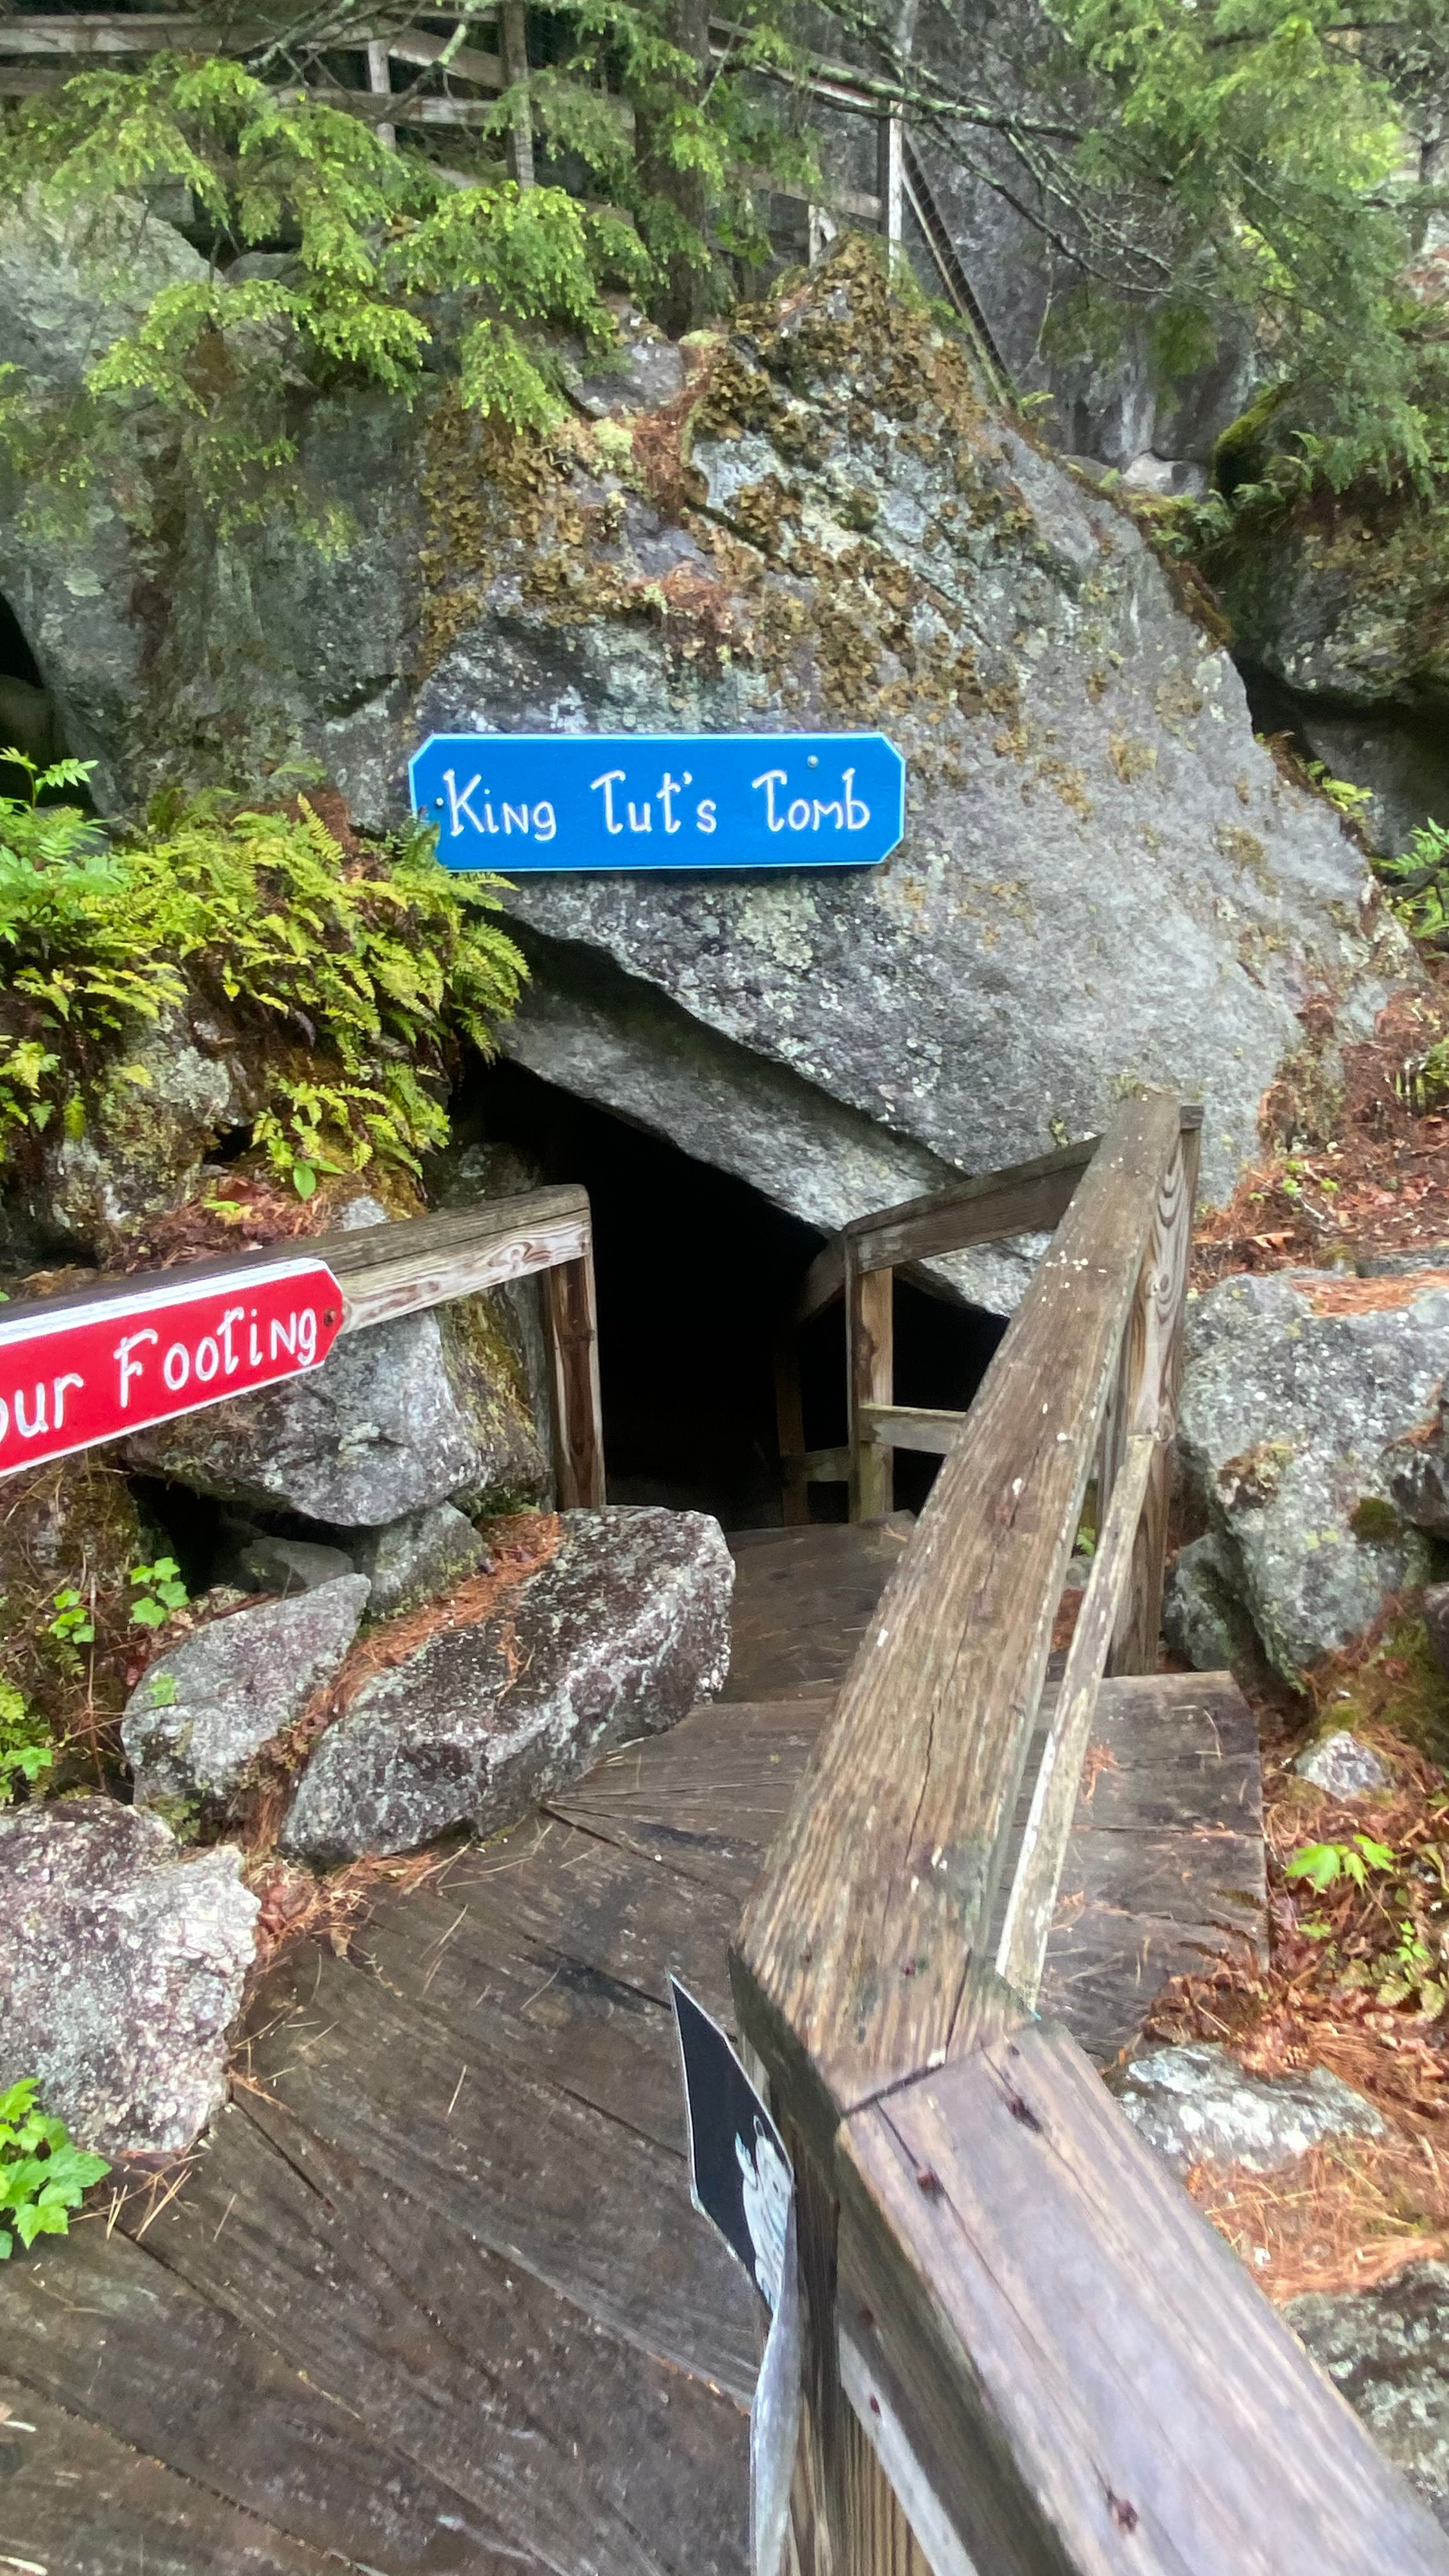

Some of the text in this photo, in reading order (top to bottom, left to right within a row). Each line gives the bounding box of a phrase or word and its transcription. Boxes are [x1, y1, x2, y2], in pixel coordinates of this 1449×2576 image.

[442, 767, 871, 841] King Tut's Tomb
[113, 1306, 318, 1409] Footing
